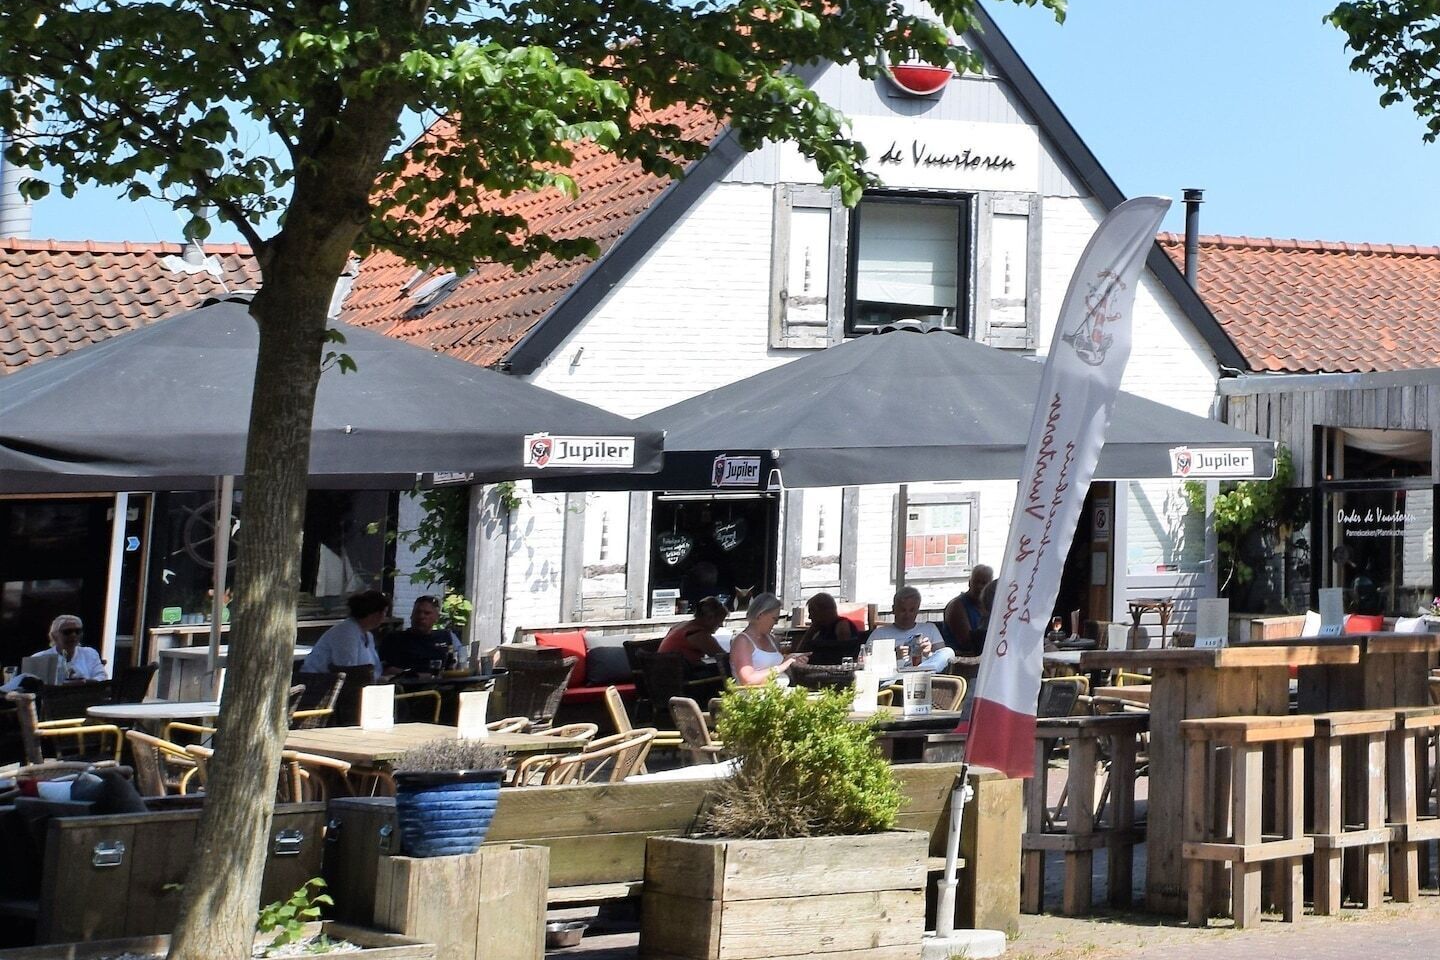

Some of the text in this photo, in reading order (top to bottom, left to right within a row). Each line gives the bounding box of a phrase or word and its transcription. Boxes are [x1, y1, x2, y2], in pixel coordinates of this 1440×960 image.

[880, 139, 1017, 170] de Vuurtoren
[556, 441, 629, 461] Jupiler
[725, 461, 758, 480] Jupiler
[1197, 453, 1249, 470] Jupiler
[1337, 506, 1417, 523] Onder de Vuurtoren
